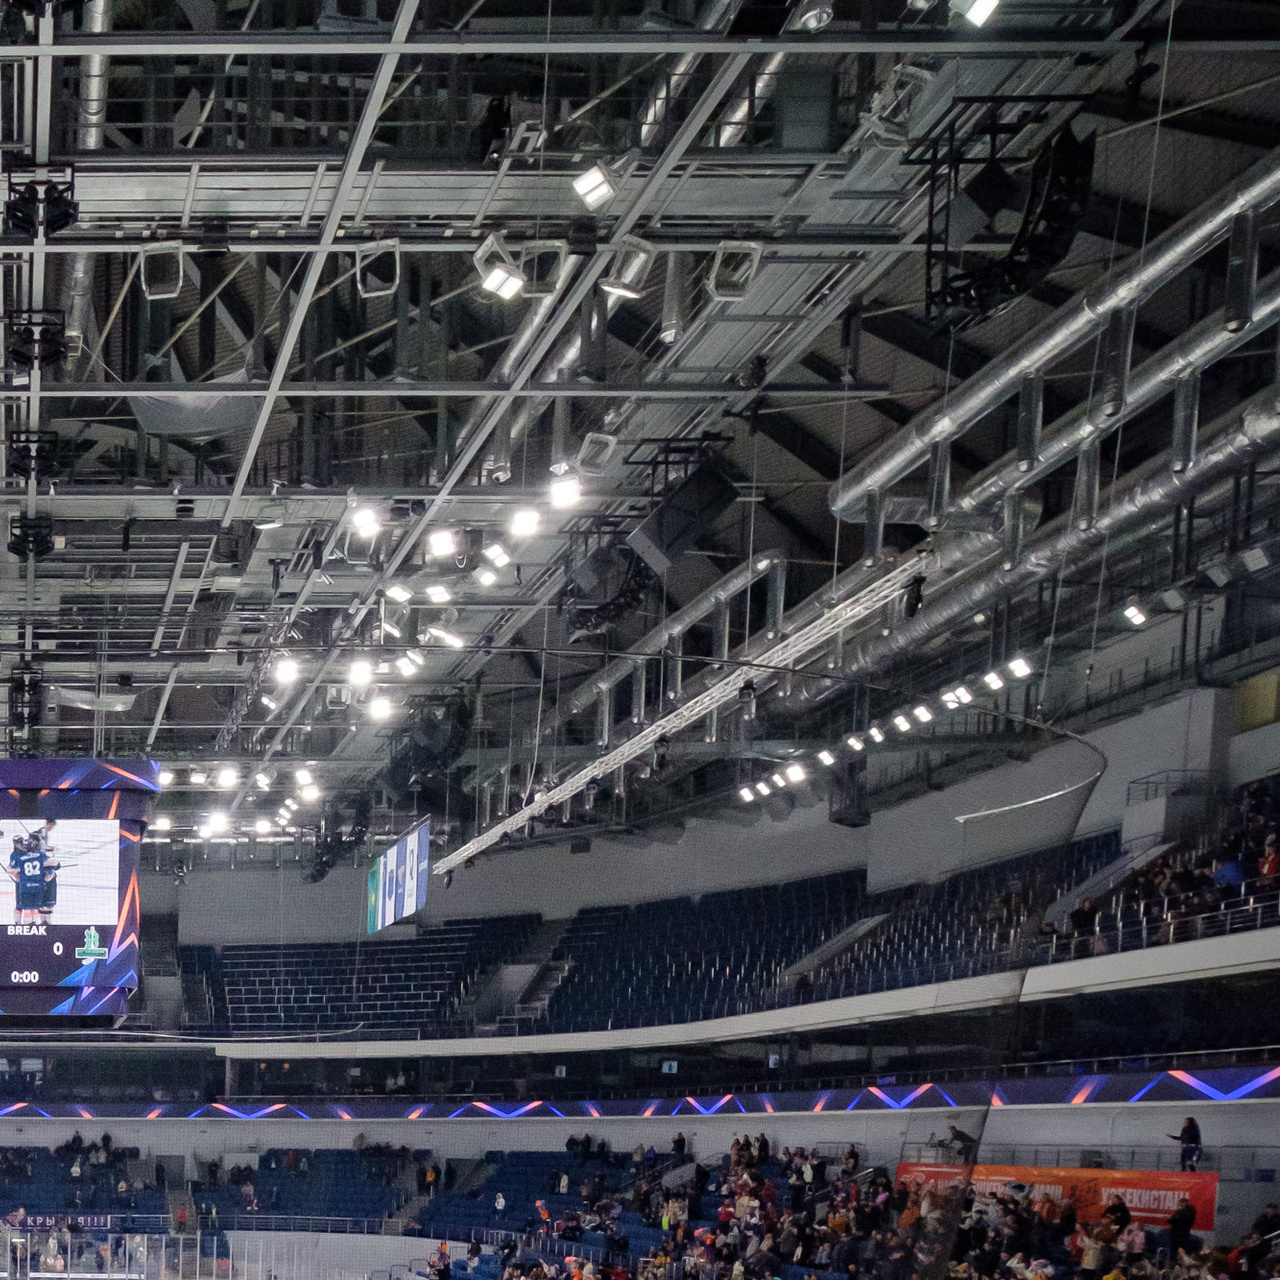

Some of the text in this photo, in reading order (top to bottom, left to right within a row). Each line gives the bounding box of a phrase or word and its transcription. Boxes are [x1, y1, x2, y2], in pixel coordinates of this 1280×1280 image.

[24, 861, 40, 876] 82
[7, 925, 47, 936] BREAK
[53, 942, 63, 955] 0
[11, 971, 39, 983] 0:00
